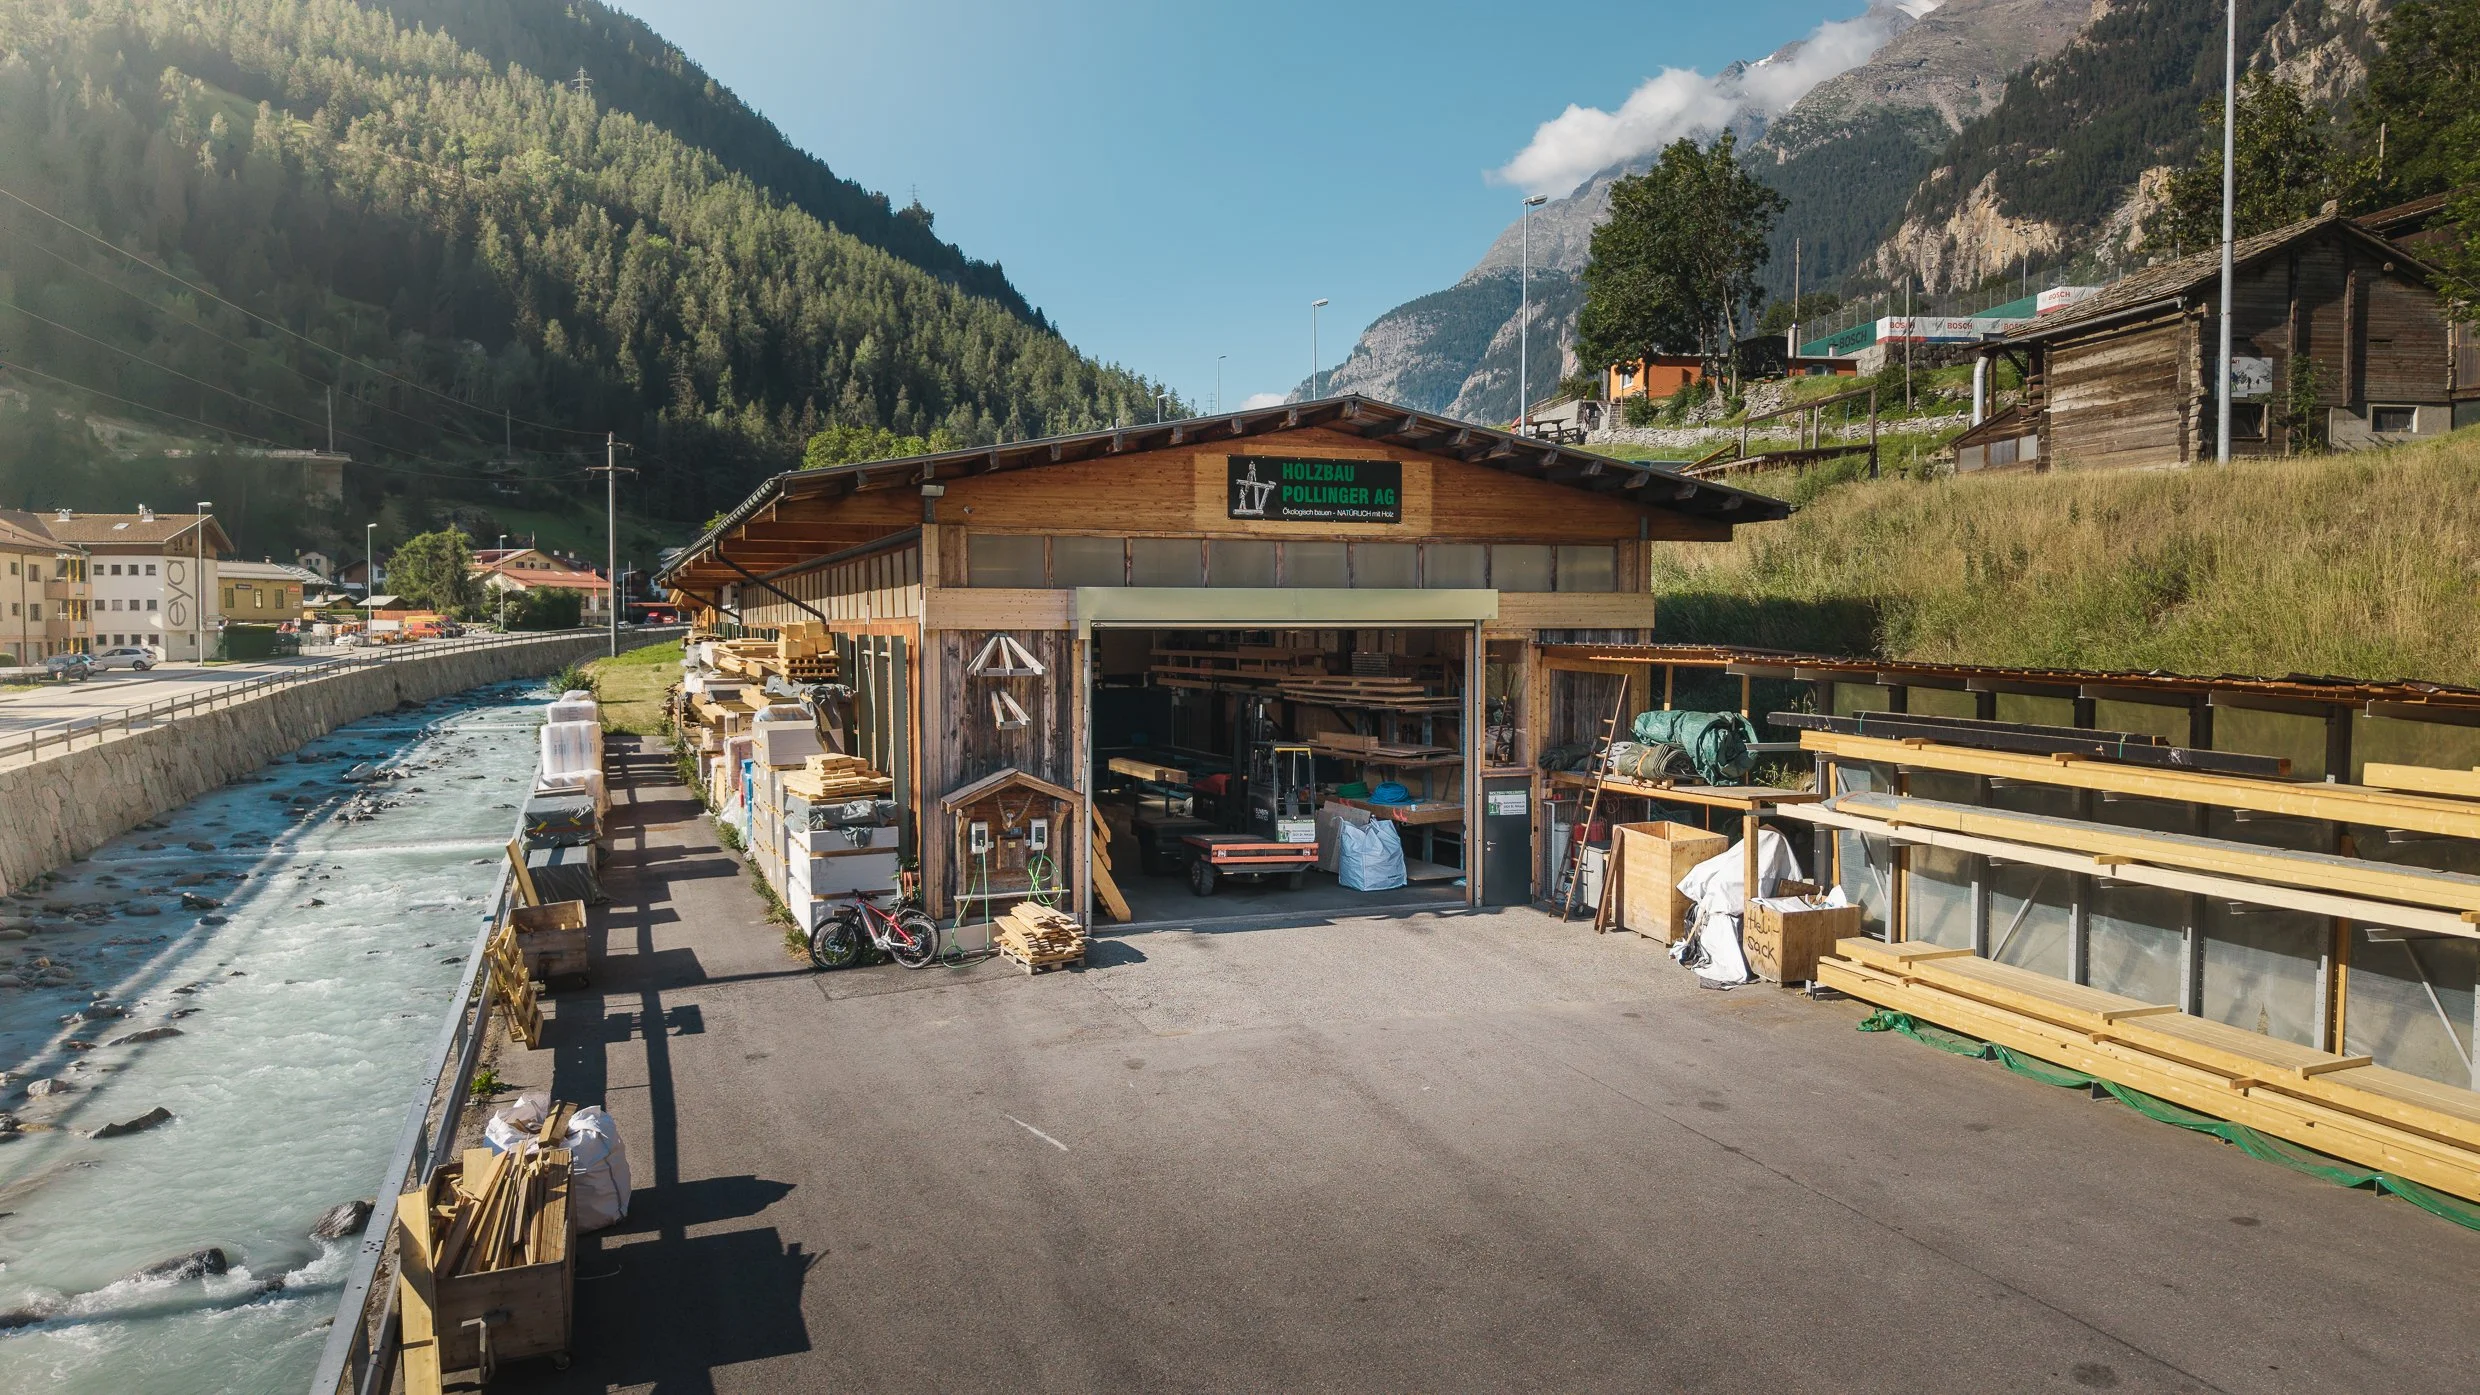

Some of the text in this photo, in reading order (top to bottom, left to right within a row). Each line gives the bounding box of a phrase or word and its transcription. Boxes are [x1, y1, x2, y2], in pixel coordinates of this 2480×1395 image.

[2049, 291, 2071, 300] BOSCH
[1947, 322, 1973, 330] BOSCH
[1839, 330, 1868, 348] BOSCH
[1282, 463, 1355, 482] HOLZBAU
[1282, 485, 1395, 506] POLLINGER AG
[1282, 506, 1314, 517] Ökologisch
[1336, 508, 1372, 517] NATÜRLICH
[1381, 510, 1394, 518] Holz
[167, 560, 193, 626] eya
[1747, 912, 1780, 934] Heli-
